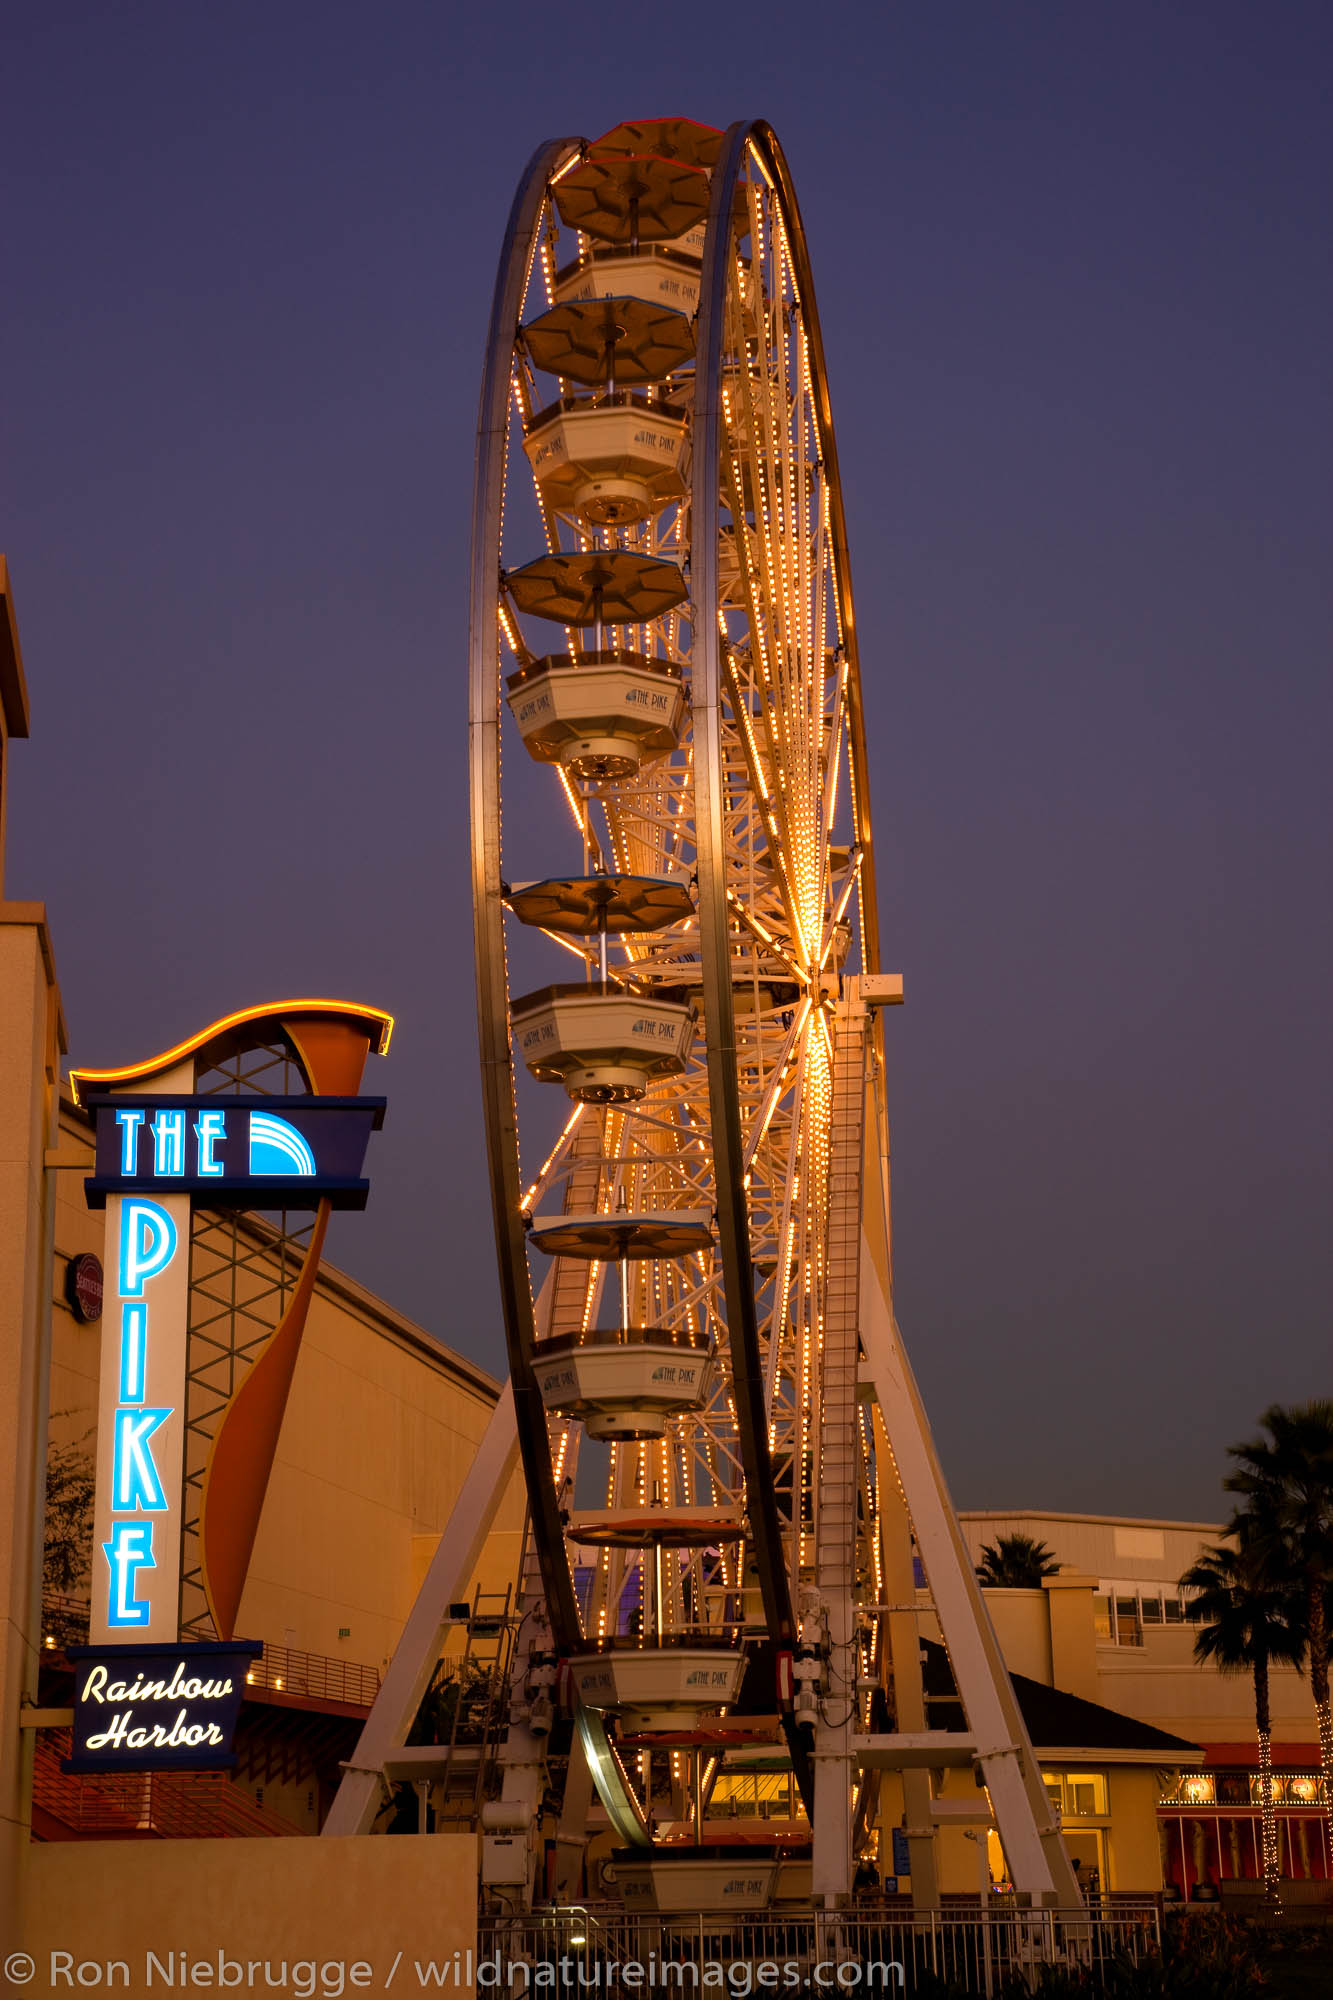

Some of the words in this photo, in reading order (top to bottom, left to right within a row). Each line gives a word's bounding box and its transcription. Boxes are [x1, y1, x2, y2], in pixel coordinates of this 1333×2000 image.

[659, 433, 675, 451] PIKE
[637, 689, 649, 705] THE
[652, 693, 667, 709] PIKE
[643, 1019, 656, 1034] THE
[659, 1022, 675, 1038] PIKE
[116, 1109, 227, 1176] THE
[663, 1367, 676, 1382] THE
[679, 1369, 695, 1384] PIKE
[102, 1197, 177, 1627] PIKE
[81, 1662, 233, 1704] Rainbow
[698, 1672, 709, 1685] THE
[712, 1671, 727, 1685] PIKE
[86, 1709, 223, 1749] Harbor
